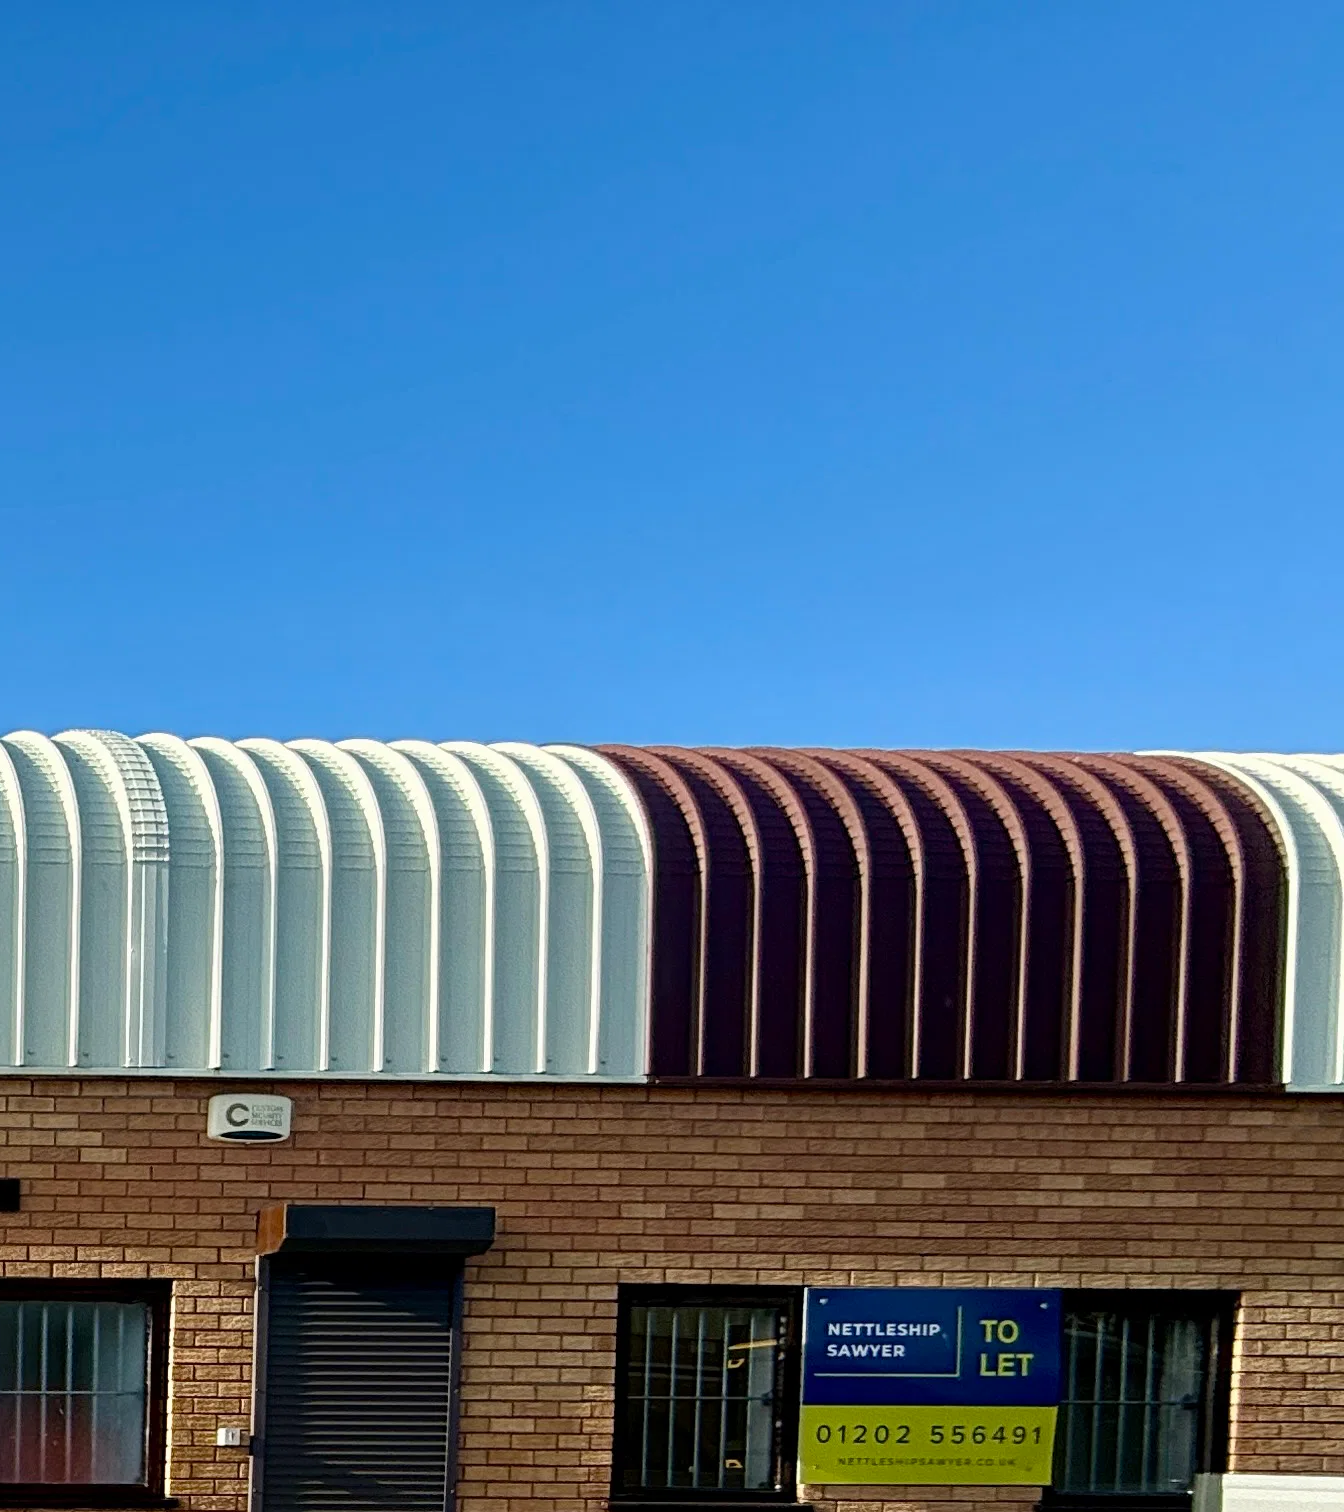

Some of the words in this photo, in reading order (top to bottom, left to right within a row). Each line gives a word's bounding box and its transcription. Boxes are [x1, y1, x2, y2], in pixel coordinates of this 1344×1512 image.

[828, 1323, 941, 1337] NETTLESHIP
[980, 1320, 1019, 1344] TO
[827, 1344, 905, 1357] SAWYER
[980, 1353, 1034, 1377] LET
[816, 1424, 911, 1444] 01202
[929, 1425, 1042, 1445] 556491
[837, 1456, 1017, 1467] NETTLESHIPSAWYER.CO.UK
